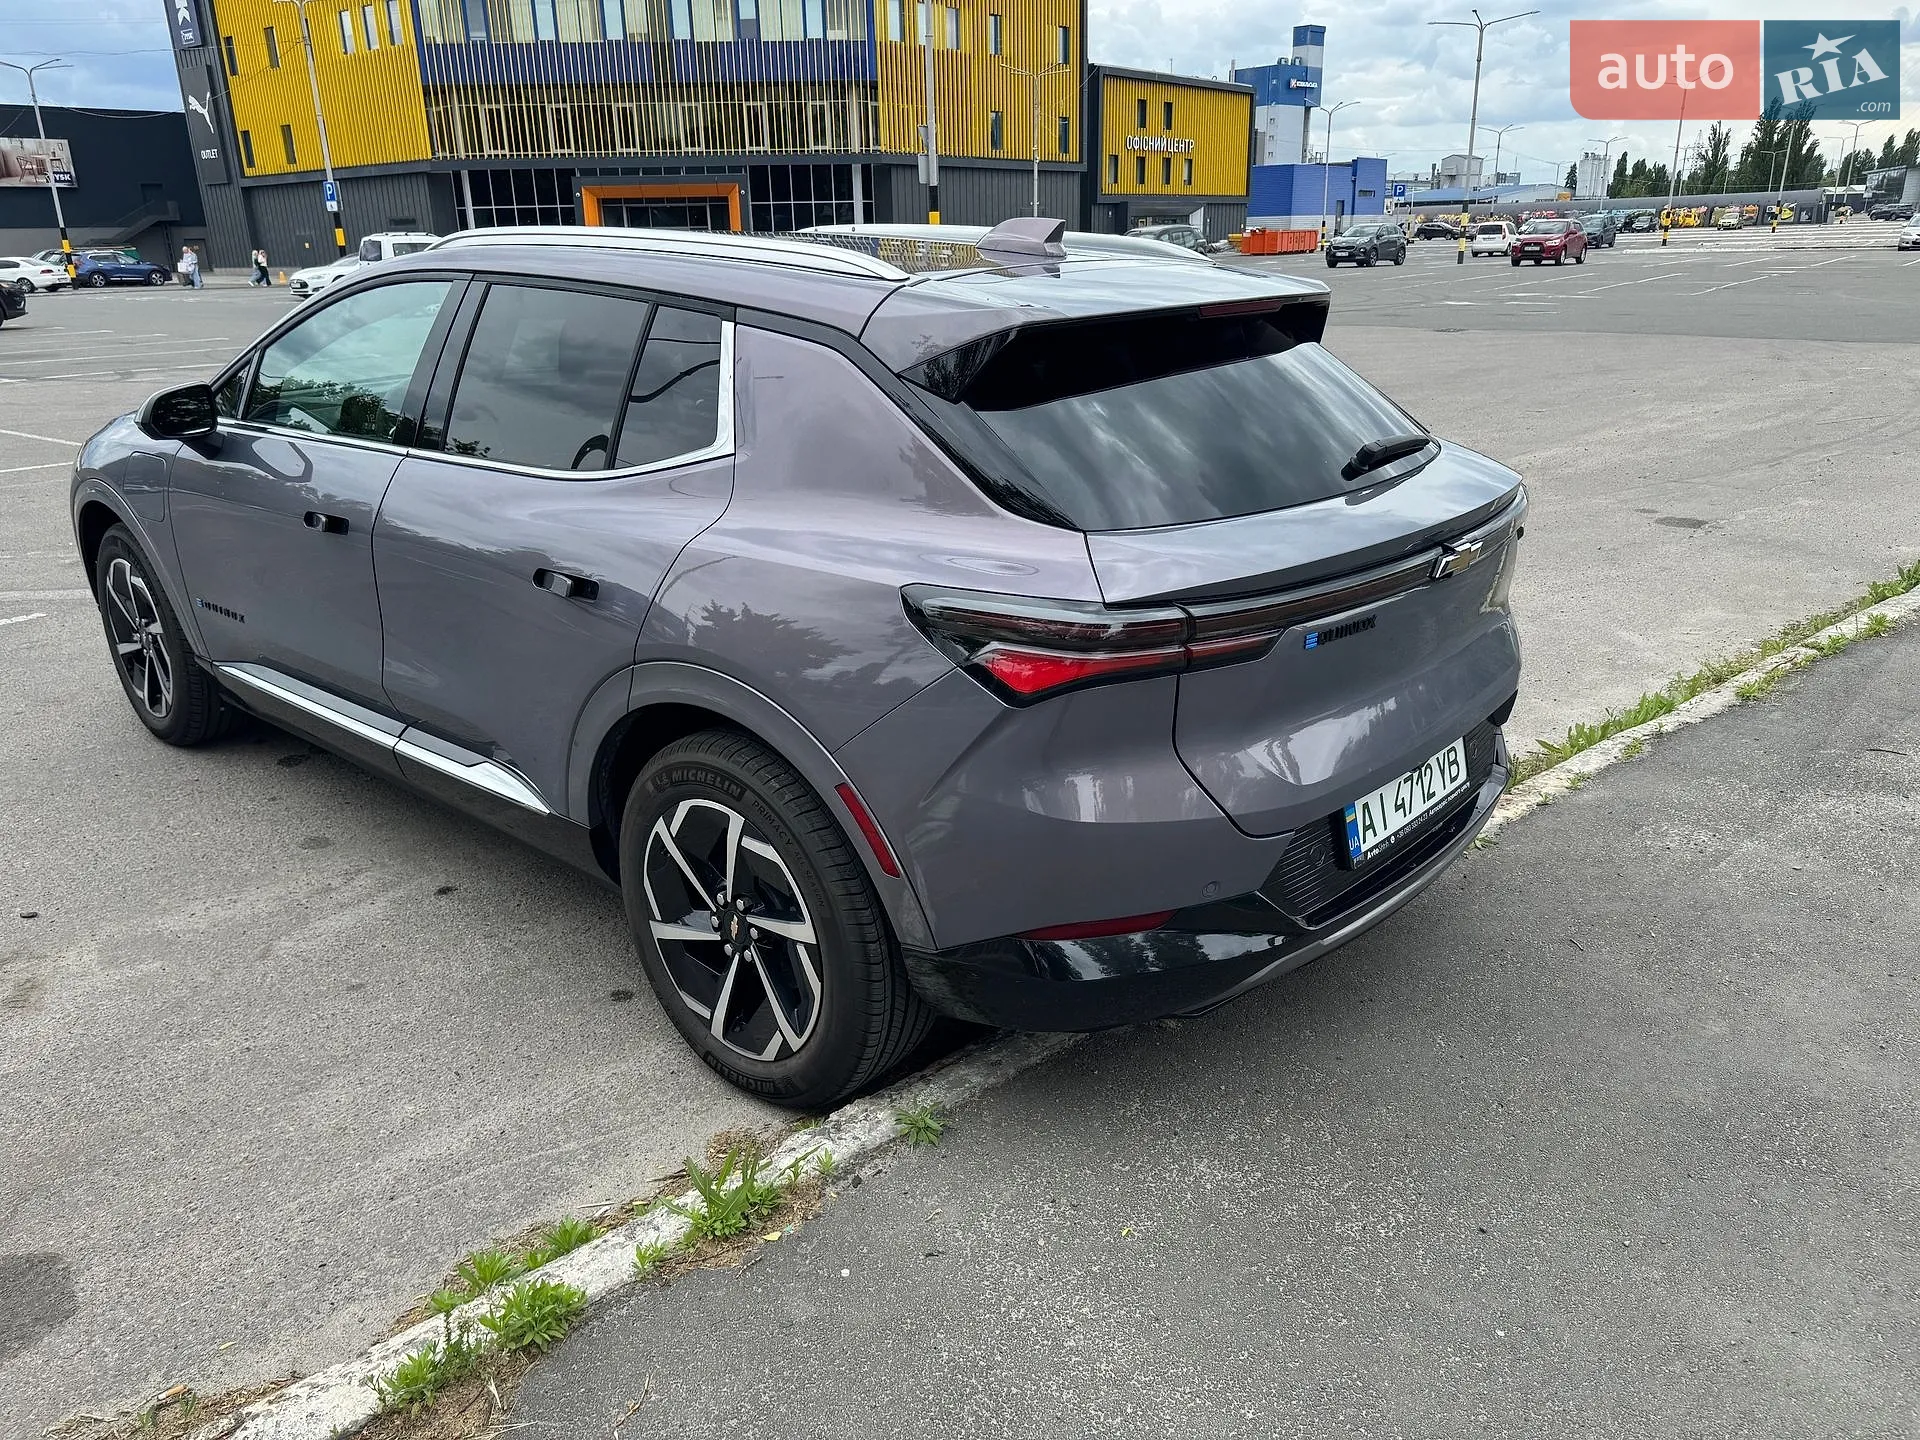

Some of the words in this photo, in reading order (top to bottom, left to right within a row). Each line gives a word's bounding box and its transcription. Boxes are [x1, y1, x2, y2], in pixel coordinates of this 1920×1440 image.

[1126, 135, 1167, 152] ОФІСНИЙ
[1167, 137, 1195, 155] ЦЕНТР
[200, 149, 218, 159] OUTLET
[52, 173, 71, 181] YSK
[326, 183, 333, 200] P
[1396, 185, 1404, 196] P
[671, 767, 742, 798] MICHELIN
[1394, 763, 1436, 819] 4712
[1435, 745, 1460, 791] YB
[752, 800, 793, 846] PRIMACY
[1348, 835, 1360, 851] UA
